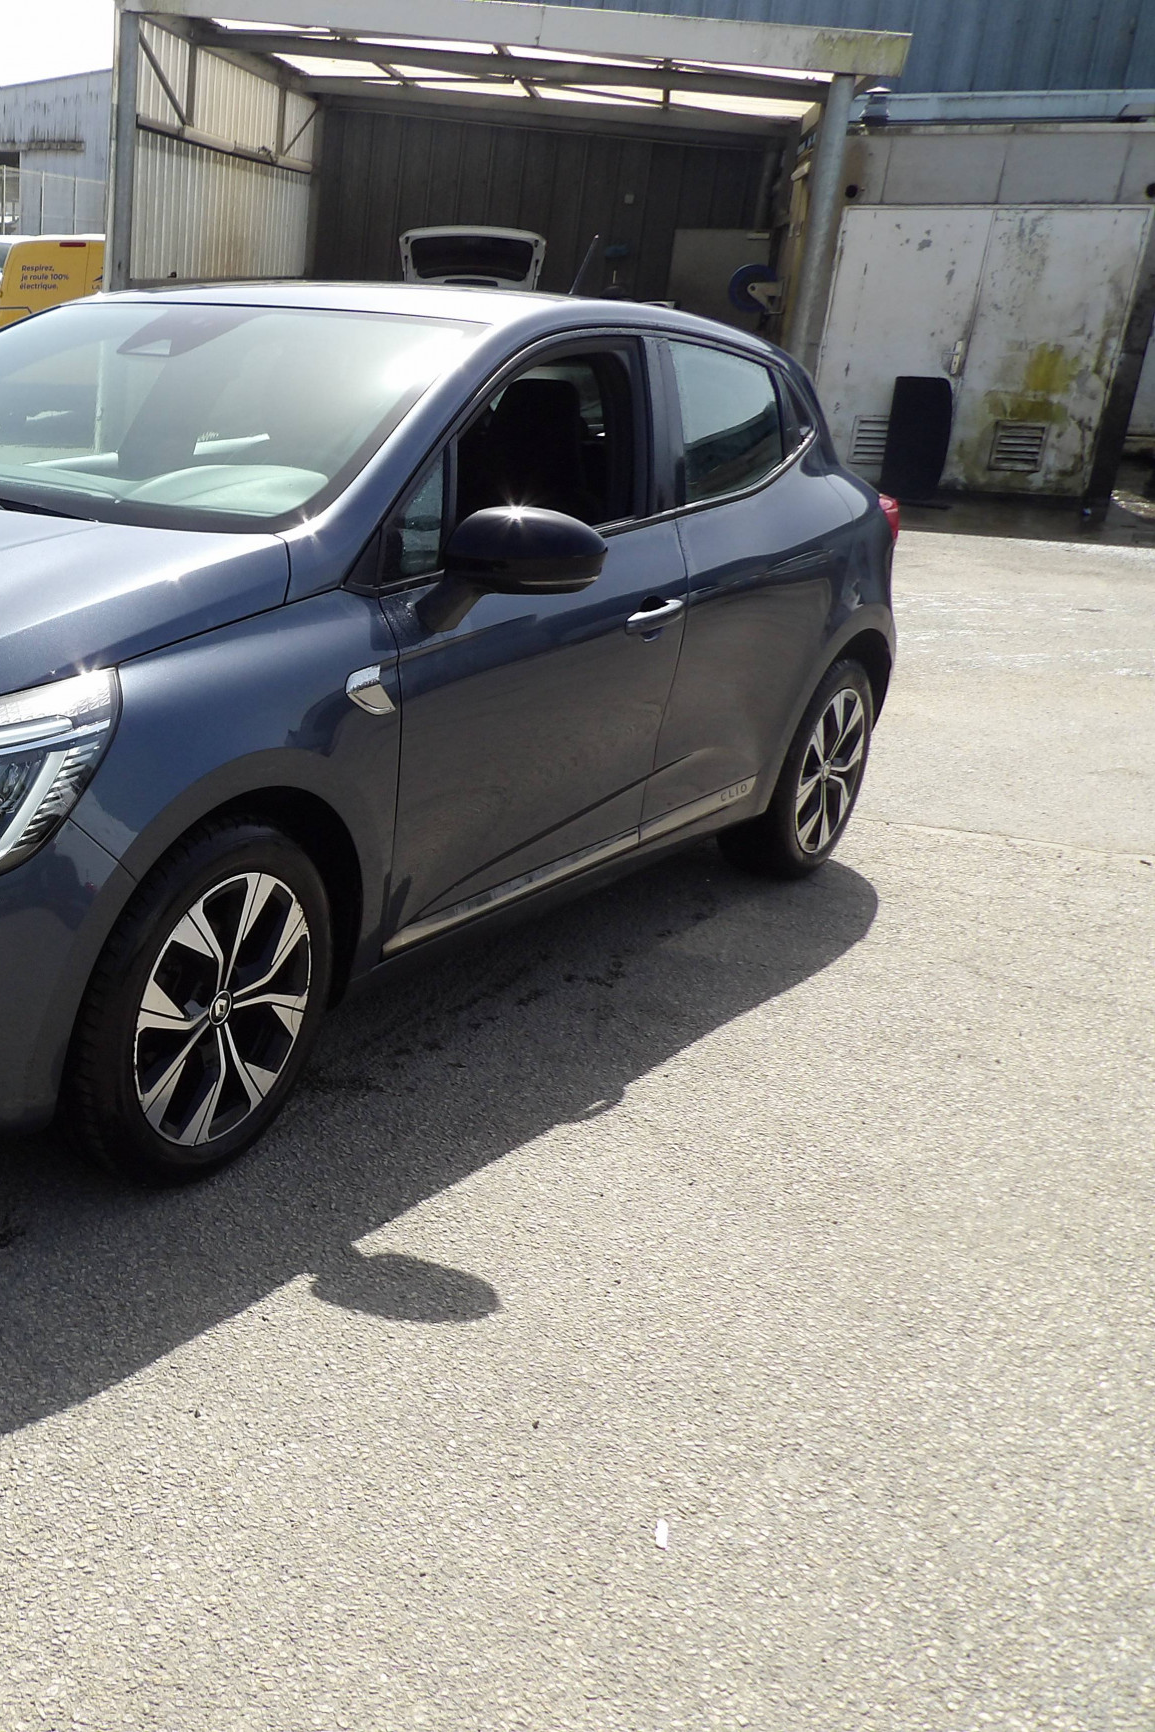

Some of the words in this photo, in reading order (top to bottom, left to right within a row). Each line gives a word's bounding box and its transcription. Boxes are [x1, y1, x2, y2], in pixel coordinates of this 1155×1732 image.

[21, 264, 54, 272] Respirez,
[21, 273, 28, 281] je
[721, 784, 747, 801] CLIO
